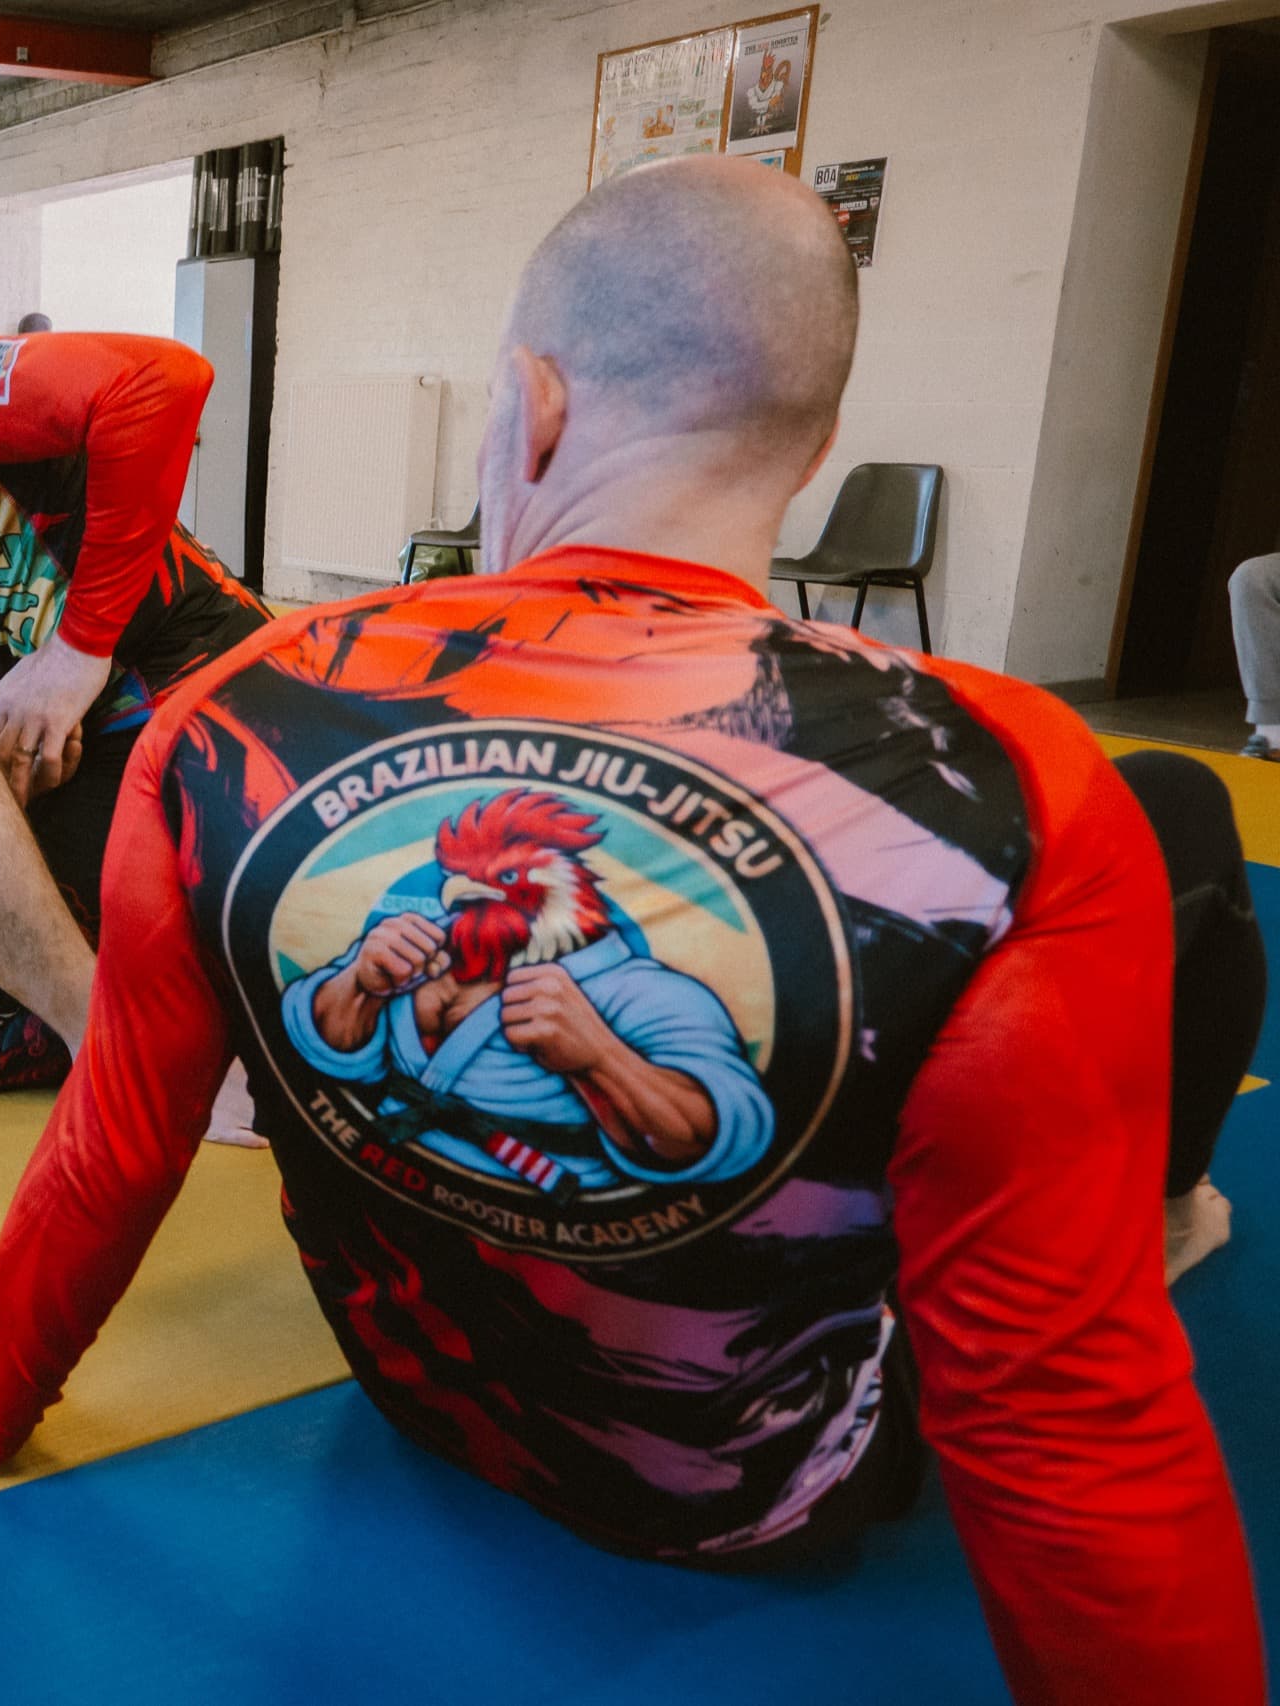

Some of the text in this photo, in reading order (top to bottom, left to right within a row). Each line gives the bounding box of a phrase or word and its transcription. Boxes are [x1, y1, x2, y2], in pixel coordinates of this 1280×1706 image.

[312, 738, 784, 880] BRAZILIAN JIU-JITSU
[309, 1089, 709, 1246] THE RED ROOSTER ACADEMY
